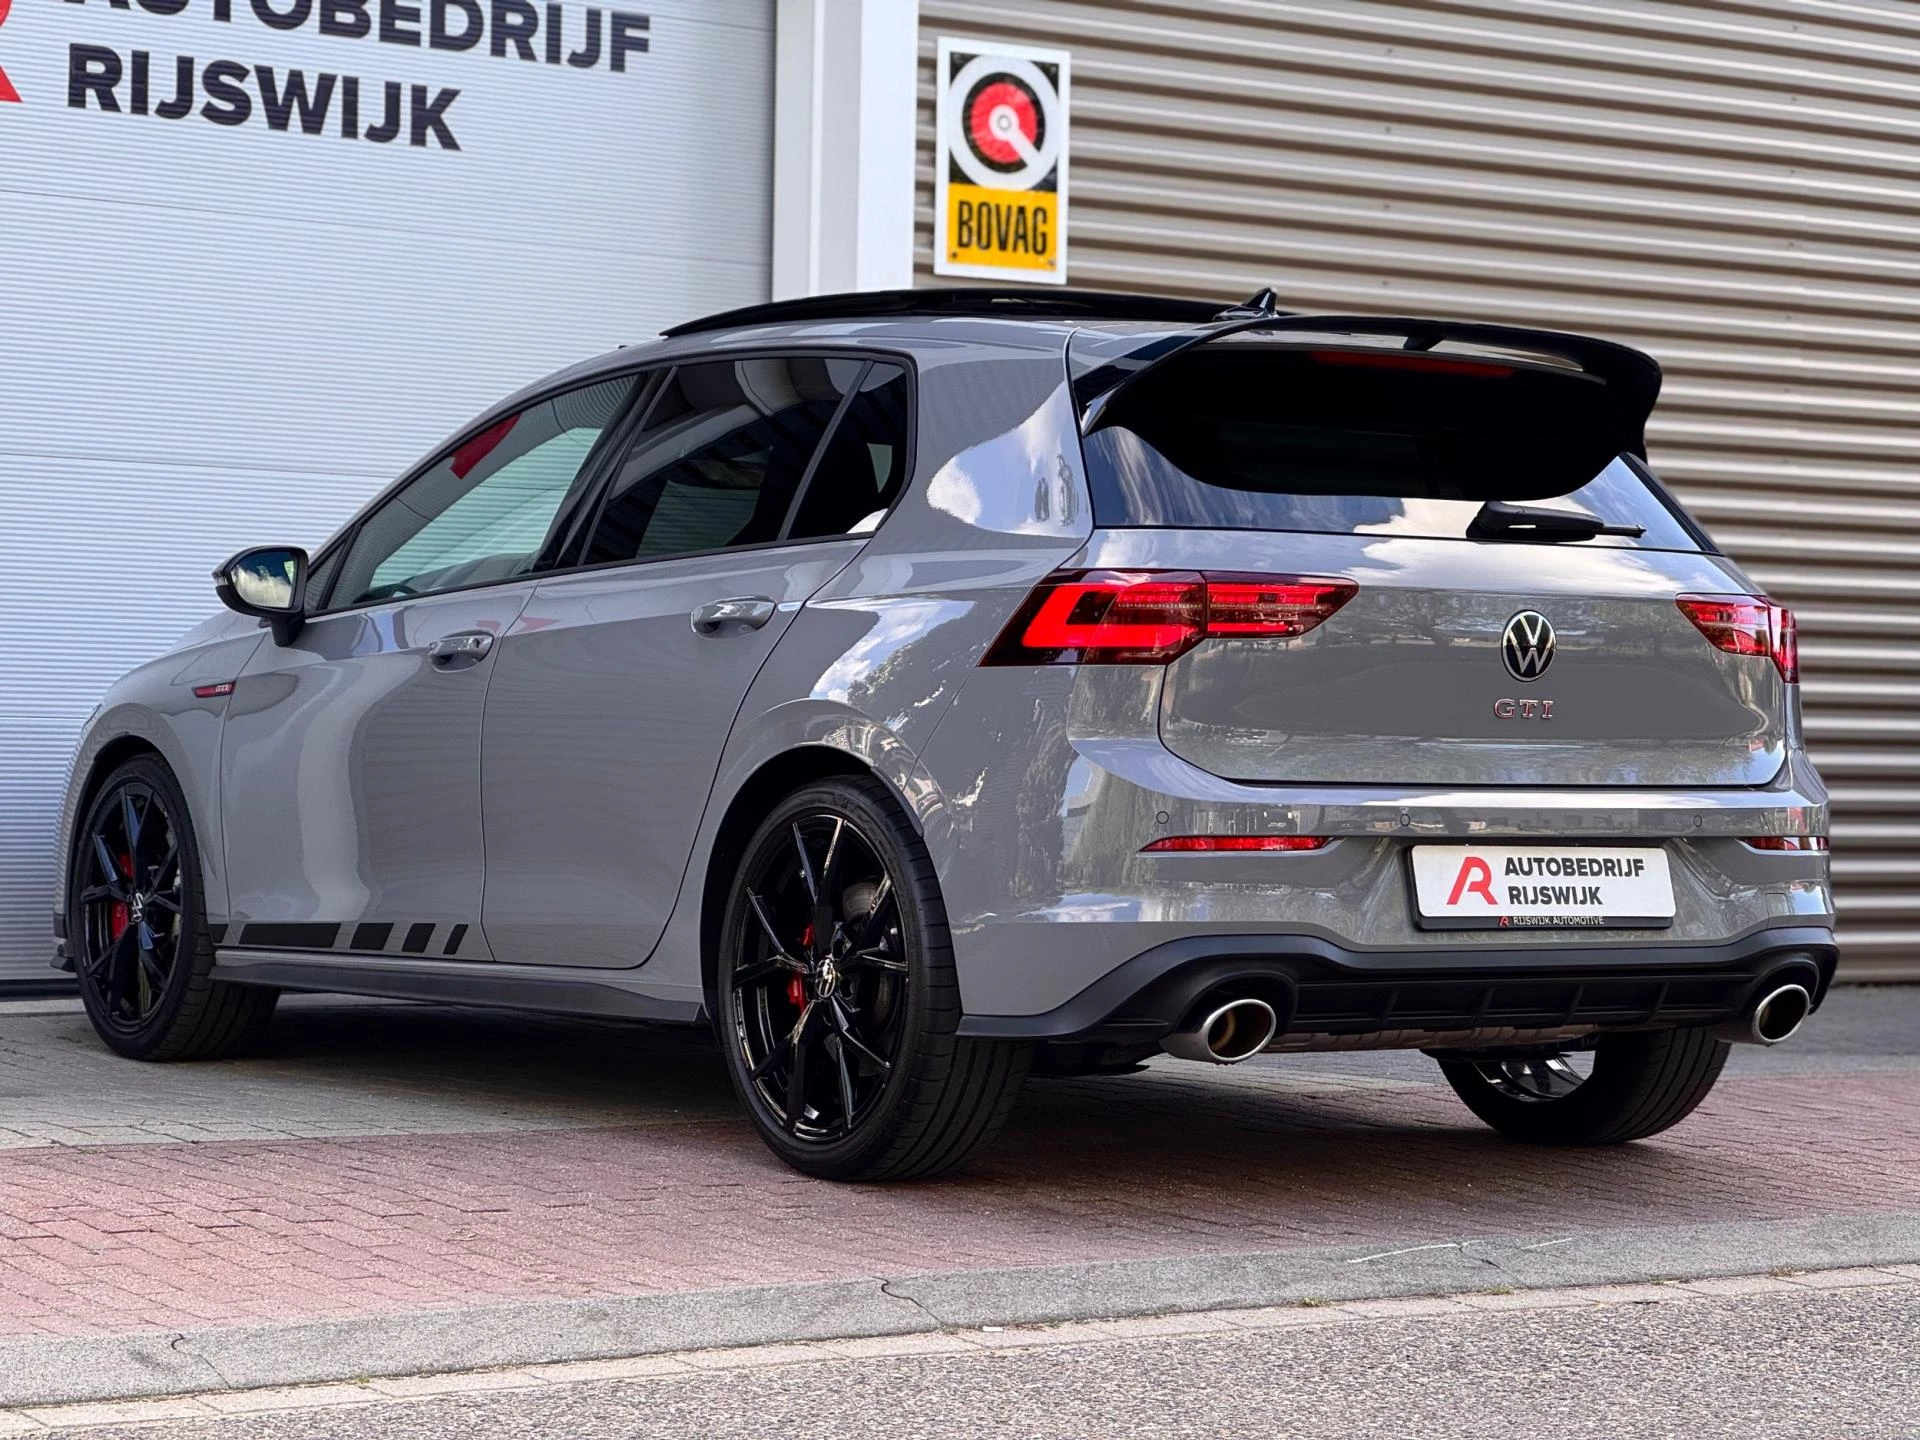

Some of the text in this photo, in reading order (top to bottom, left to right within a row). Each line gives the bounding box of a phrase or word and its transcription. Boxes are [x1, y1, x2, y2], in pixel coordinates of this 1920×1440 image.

[62, 0, 652, 74] BEDRIJF
[67, 43, 462, 152] RIJSWIJK
[957, 200, 1048, 256] BOVAG
[1494, 698, 1554, 719] GTI
[1504, 857, 1645, 877] AUTOBEDRIJF
[1507, 886, 1604, 905] RIJSWIJK
[1513, 916, 1605, 925] RIJSWIJK AUTOMOTIVE
